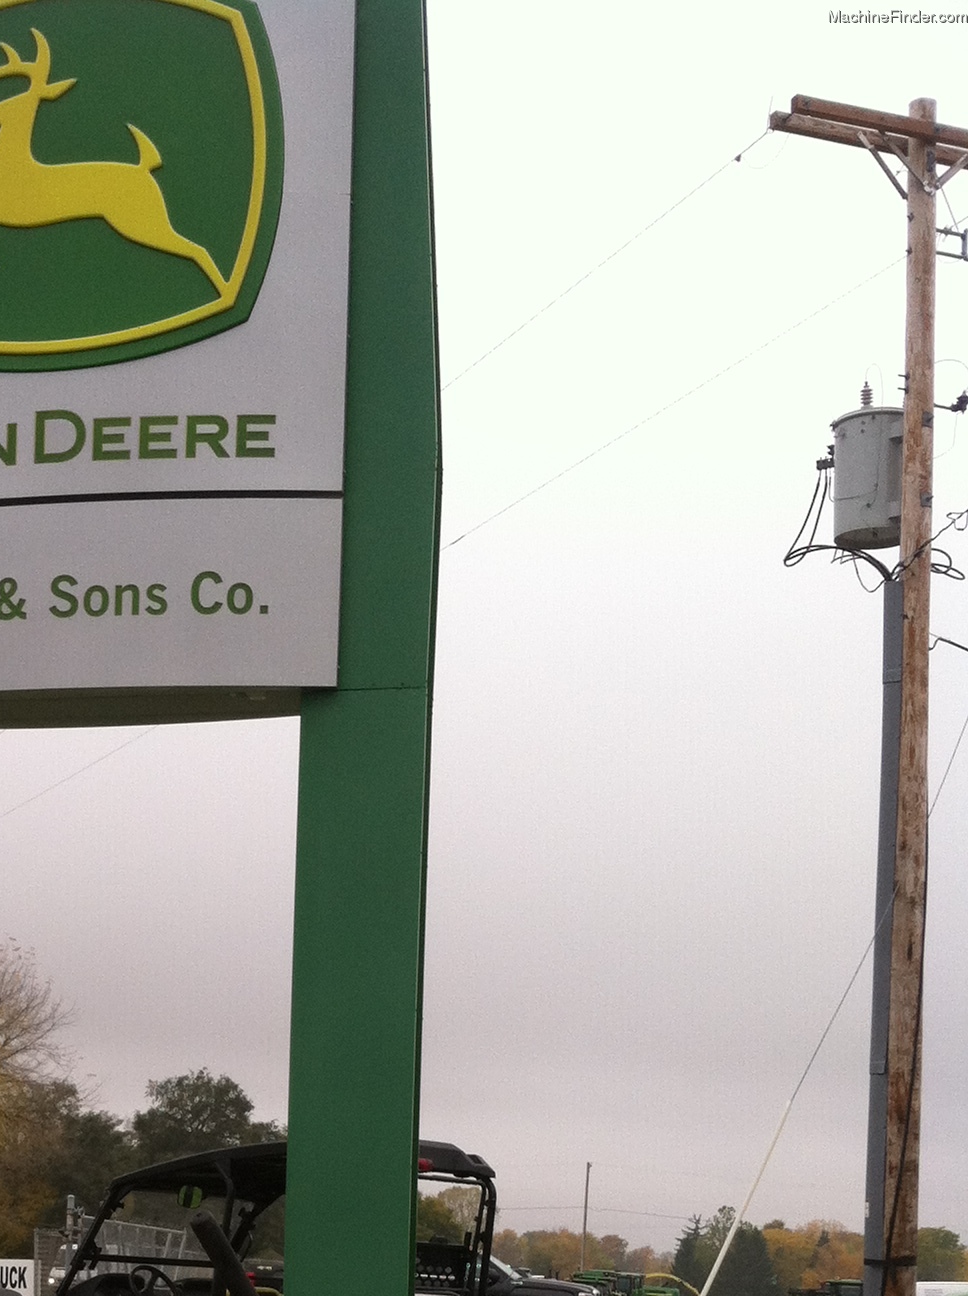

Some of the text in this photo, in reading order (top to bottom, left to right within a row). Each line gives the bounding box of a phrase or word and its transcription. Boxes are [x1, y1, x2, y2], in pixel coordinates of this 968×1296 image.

[33, 409, 277, 464] DEERE
[49, 575, 169, 618] Sons
[190, 571, 270, 616] Co.
